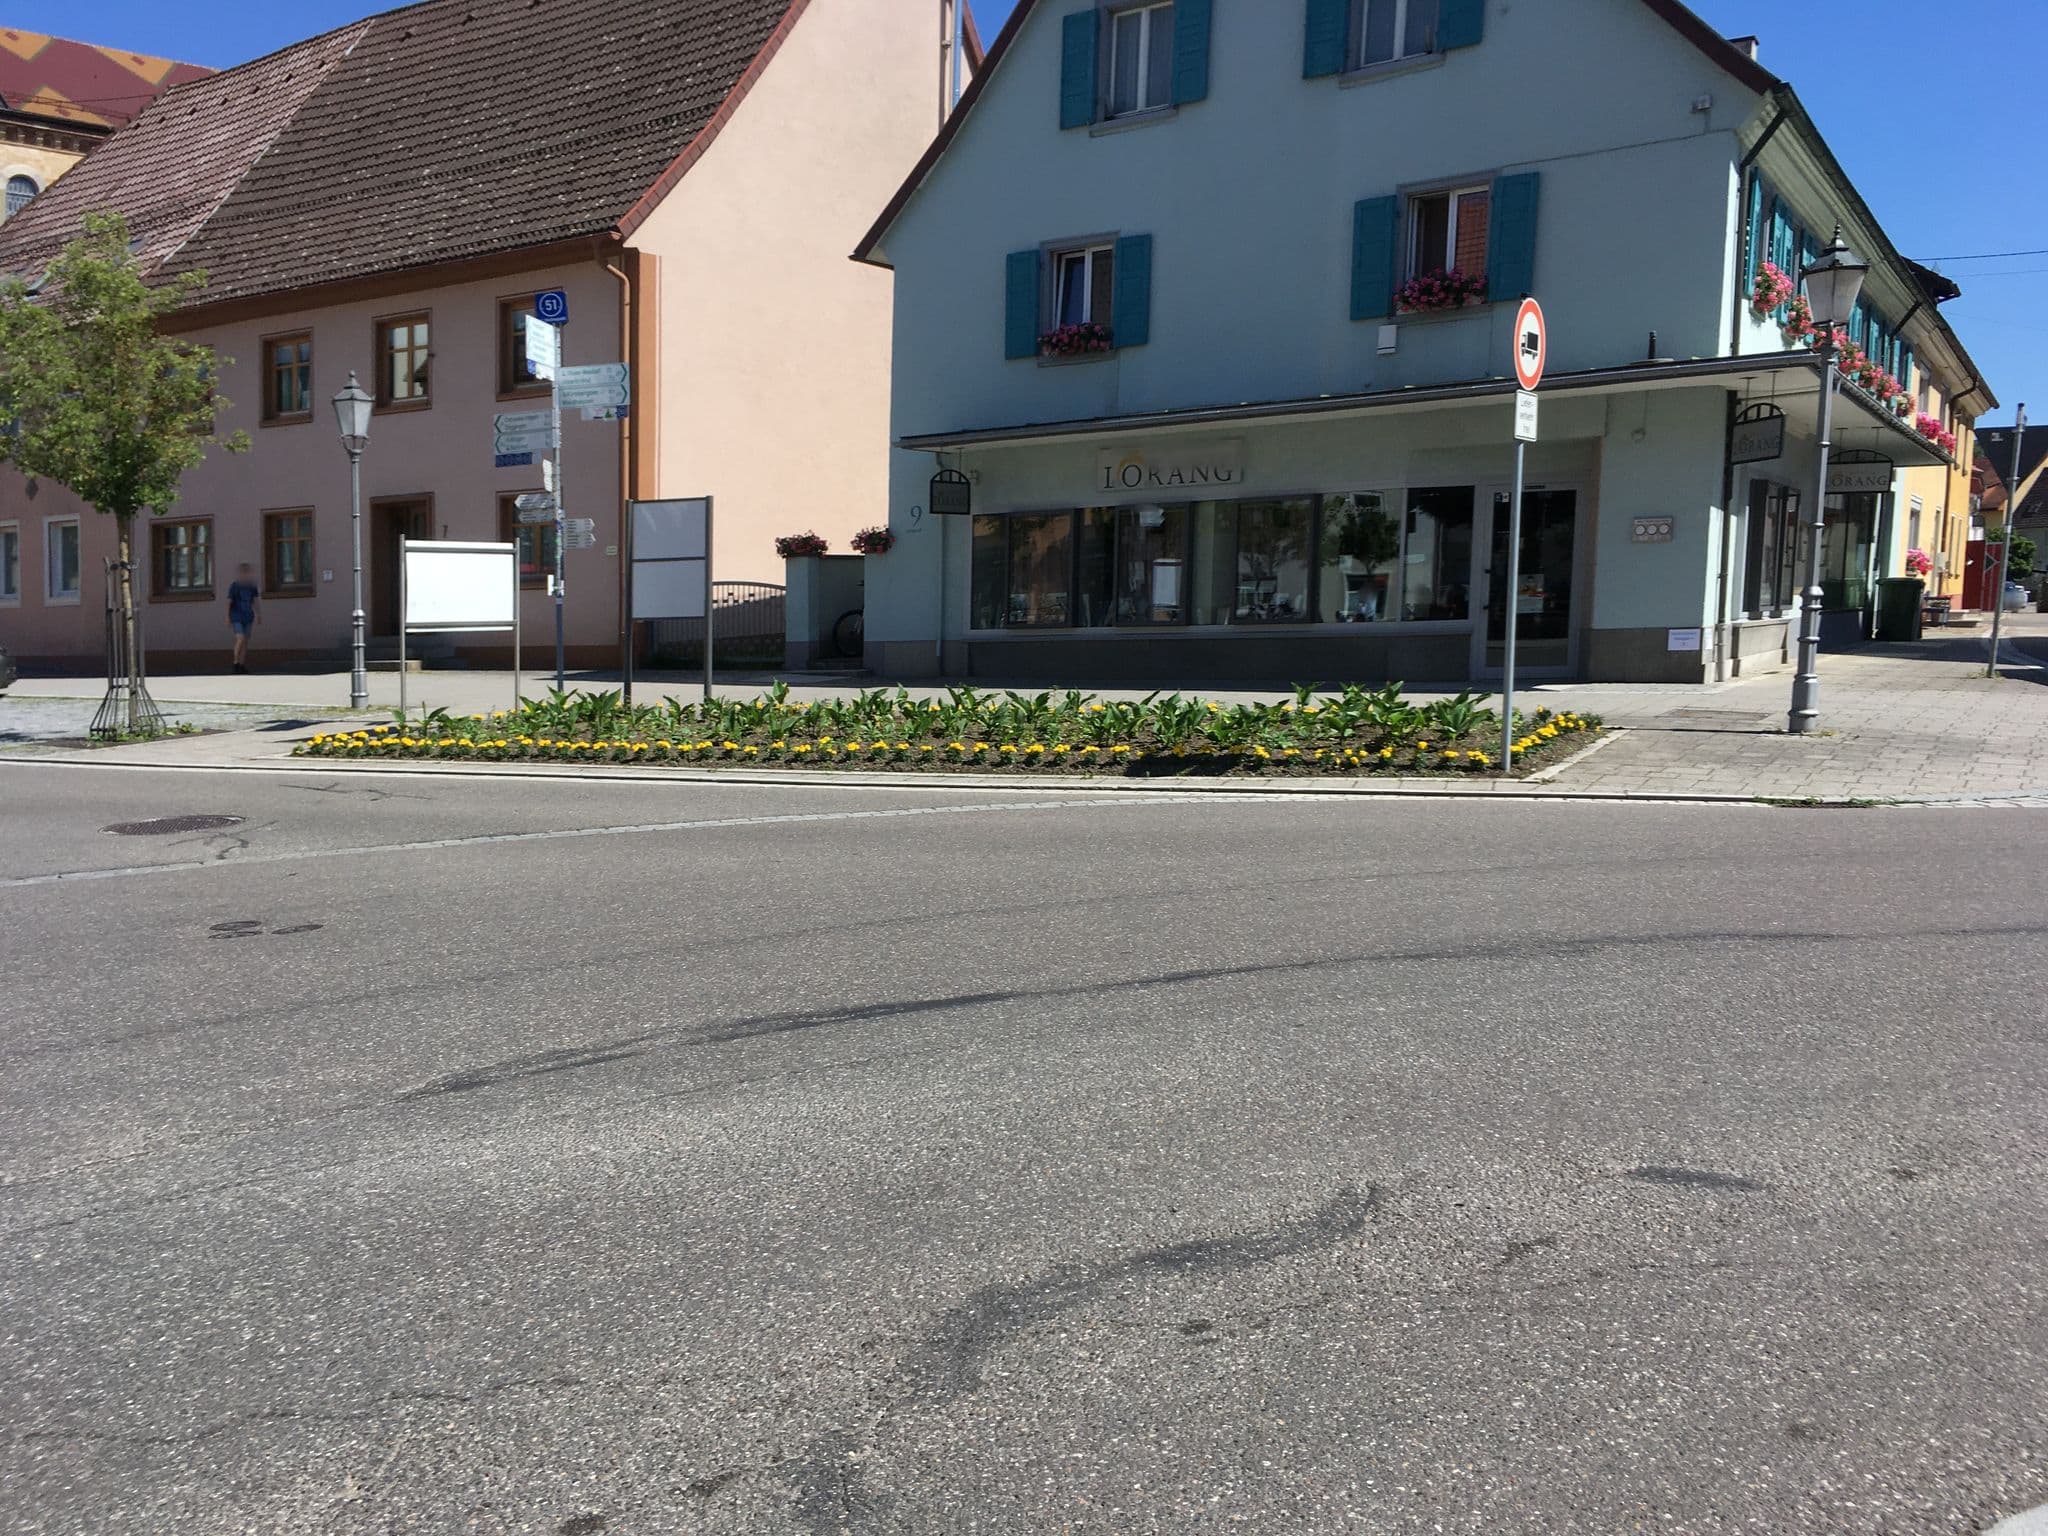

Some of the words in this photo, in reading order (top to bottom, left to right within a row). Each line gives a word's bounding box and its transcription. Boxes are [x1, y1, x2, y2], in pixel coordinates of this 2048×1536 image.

[544, 299, 558, 311] 51
[1831, 475, 1887, 487] ORANG
[910, 504, 923, 528] 9
